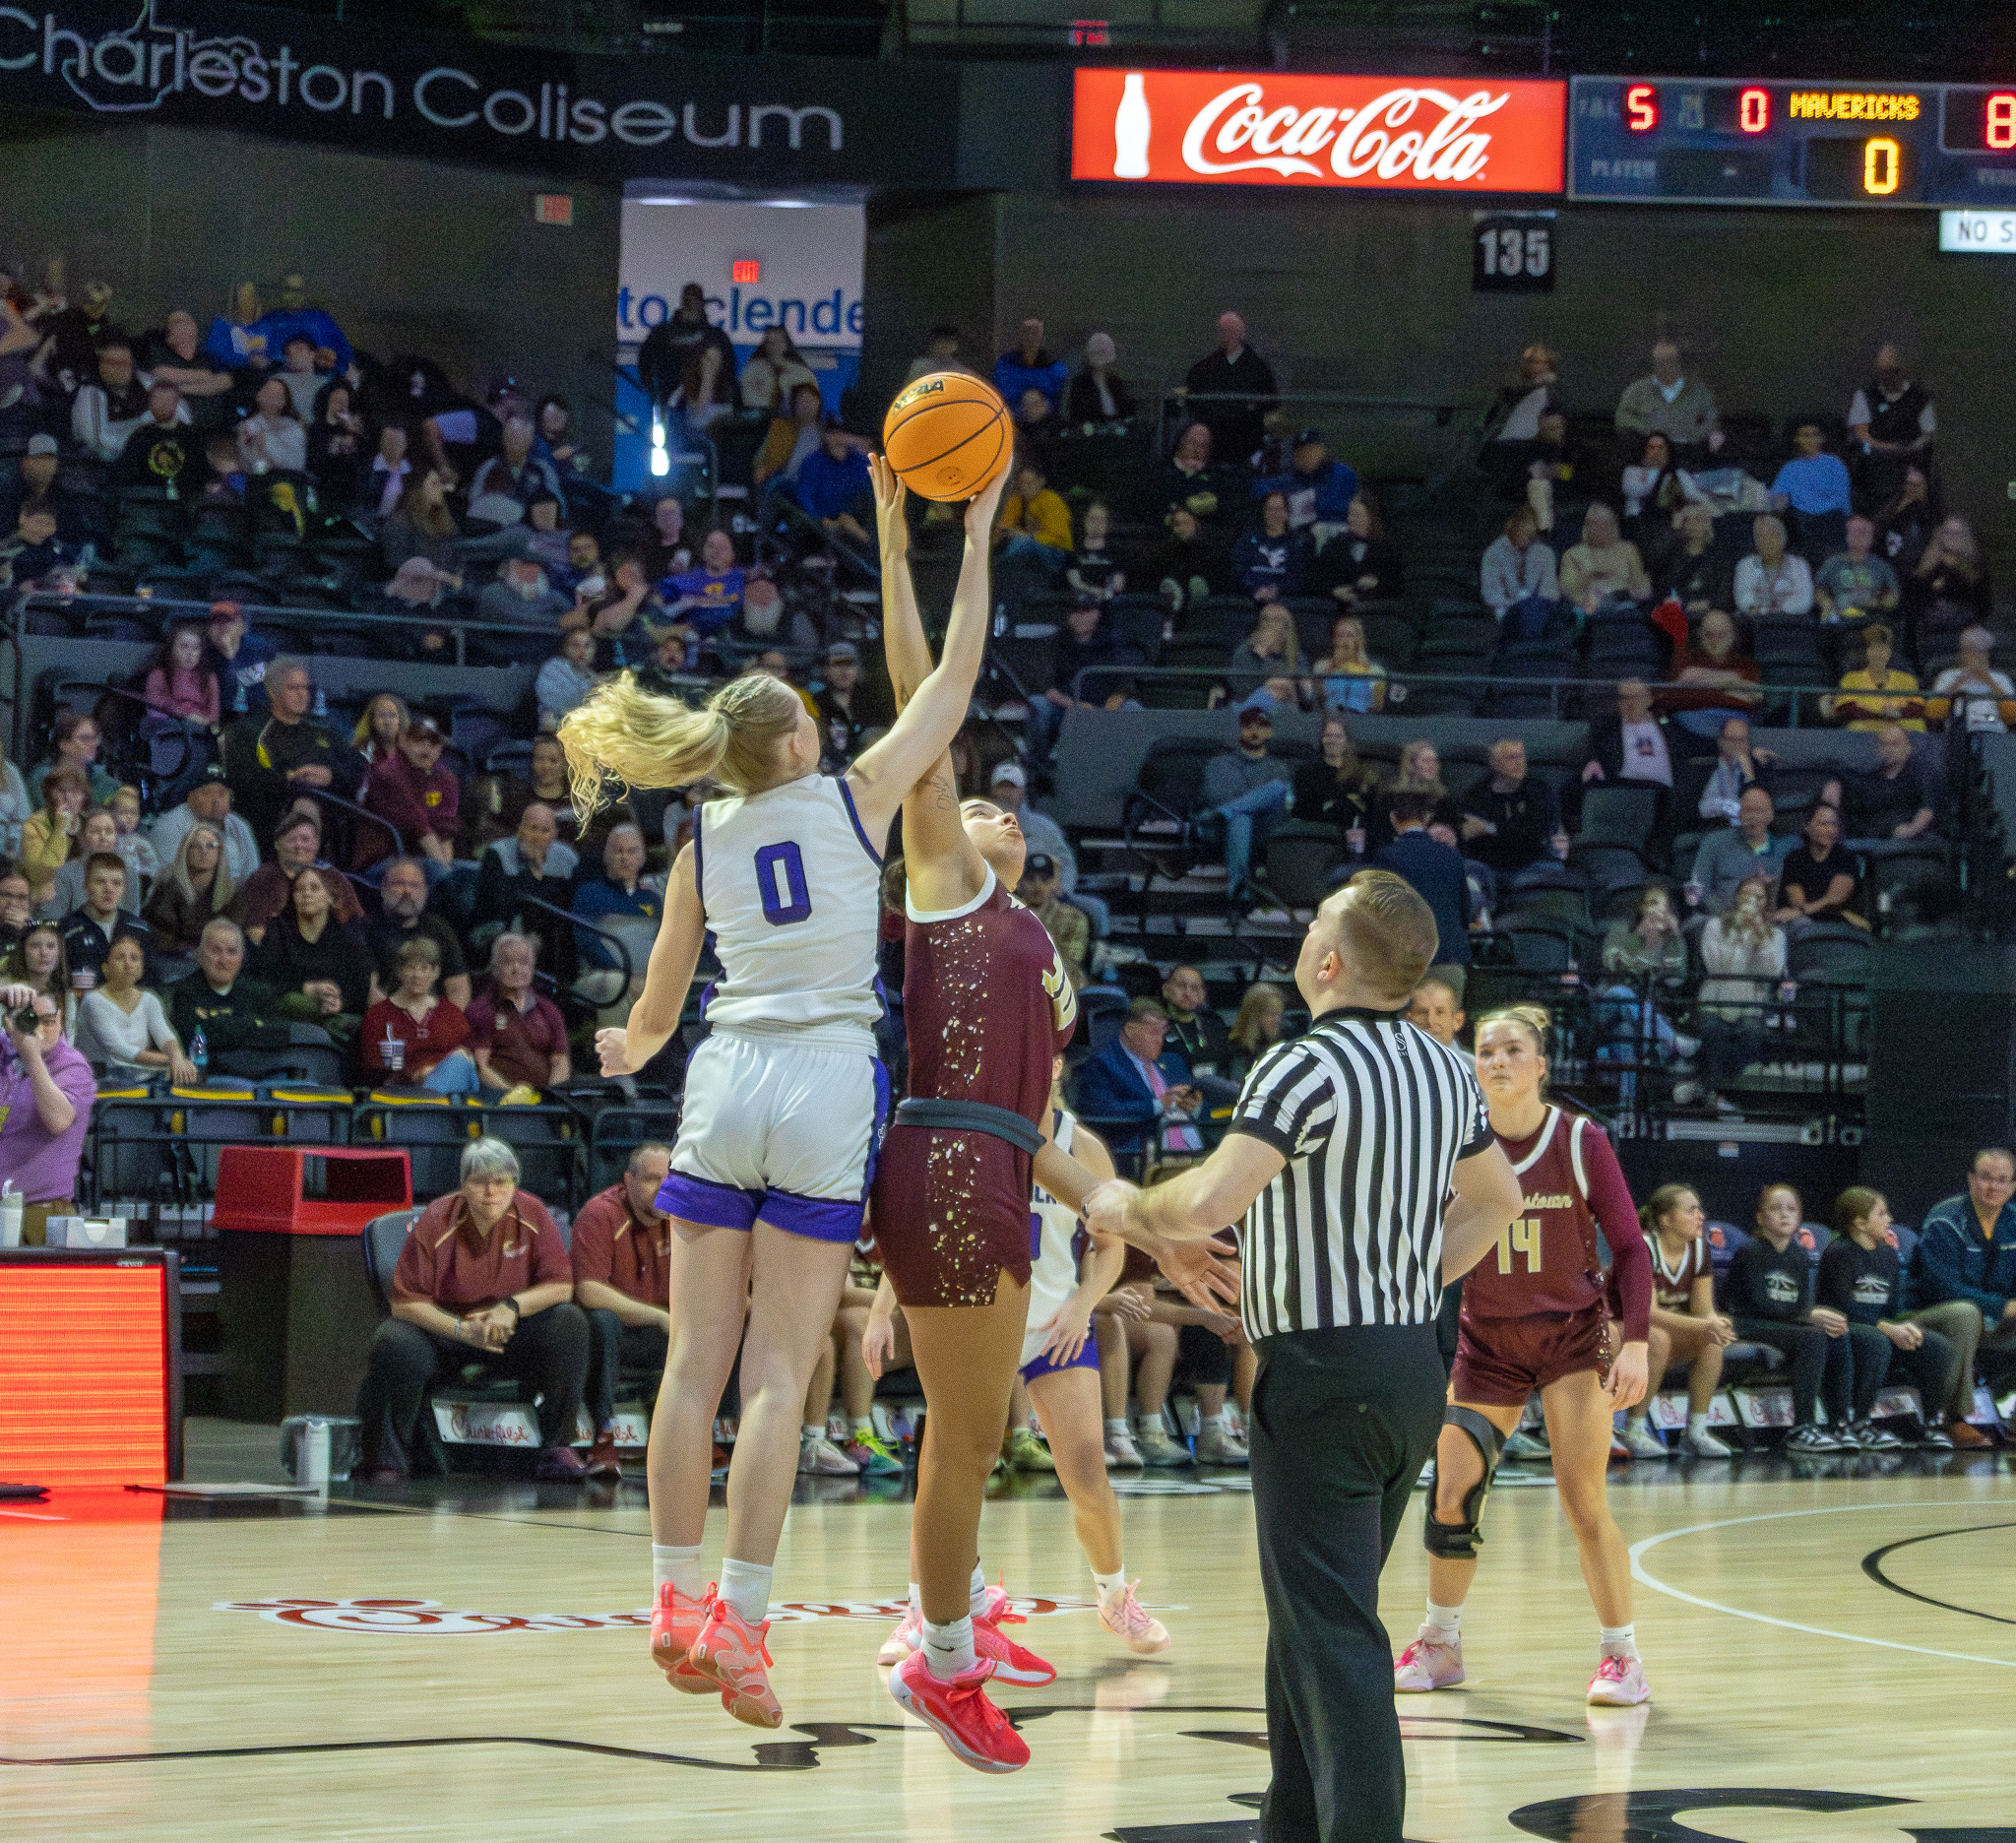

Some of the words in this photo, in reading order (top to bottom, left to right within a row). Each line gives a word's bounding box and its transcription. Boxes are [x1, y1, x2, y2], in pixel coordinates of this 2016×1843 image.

[412, 66, 844, 152] Coliseum
[1181, 83, 1511, 182] Coca-Cola
[1790, 93, 1921, 121] MAVERICKS
[1863, 138, 1900, 195] 0
[1478, 227, 1550, 277] 135
[1957, 220, 1988, 242] NO
[754, 840, 812, 926] 0
[1496, 1218, 1543, 1275] 14
